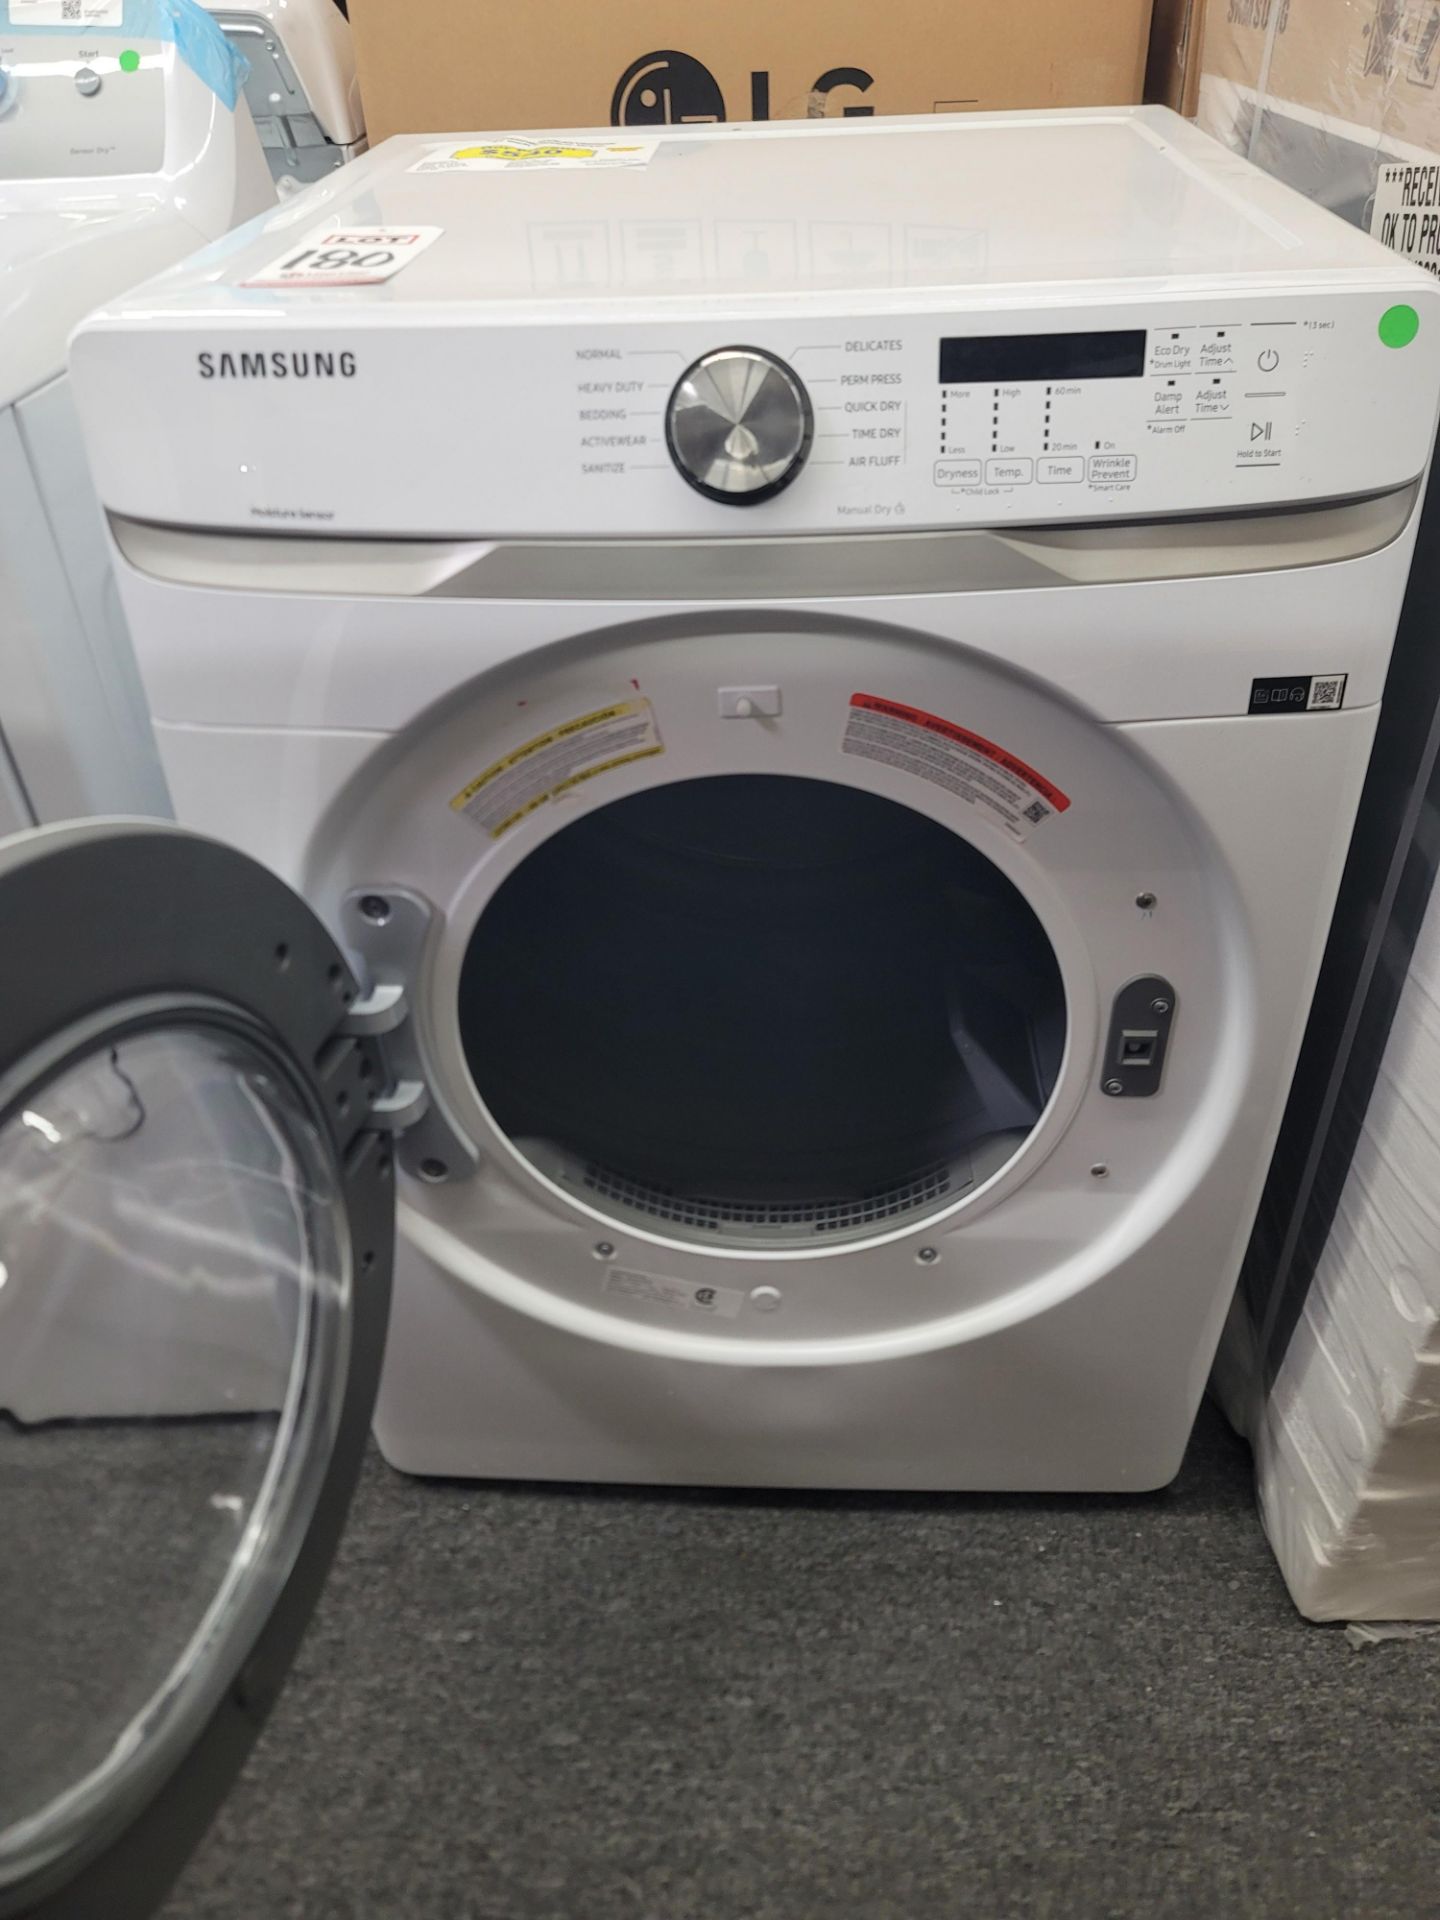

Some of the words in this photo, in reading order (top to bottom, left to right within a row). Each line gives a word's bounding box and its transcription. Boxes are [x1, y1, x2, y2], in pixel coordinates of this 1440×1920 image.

[1385, 165, 1440, 207] RECEI
[1381, 212, 1399, 250] OK
[1400, 213, 1417, 253] TO
[335, 235, 409, 244] LOT
[281, 249, 395, 270] 180
[845, 340, 903, 352] DELICATES
[1154, 345, 1171, 356] Eco
[1173, 345, 1190, 357] Dry
[1200, 344, 1232, 355] Adjust
[576, 350, 622, 360] NORMAL
[198, 352, 357, 378] SAMSUNG
[1174, 359, 1191, 370] Light
[1200, 357, 1223, 367] Time
[841, 375, 869, 386] PERM
[871, 373, 902, 384] PRESS
[578, 382, 613, 393] HEAVY
[615, 381, 644, 393] DUTY
[951, 390, 970, 398] More
[1003, 388, 1021, 398] High
[1154, 392, 1182, 404] Damp
[1196, 390, 1227, 402] Adjust
[845, 402, 877, 413] QUICK
[879, 401, 901, 411] DRY
[1155, 404, 1179, 415] Alert
[1195, 403, 1219, 413] Time
[579, 409, 626, 420] BEDDING
[852, 429, 877, 439] TIME
[879, 428, 901, 438] DRY
[1174, 425, 1185, 434] Off
[581, 436, 647, 447] ACTIVEWEAR
[1104, 441, 1115, 449] On
[949, 446, 965, 454] Less
[1000, 444, 1015, 453] Low
[1237, 449, 1254, 458] Hold
[1264, 449, 1281, 458] Start
[849, 457, 866, 467] AIR
[868, 456, 901, 466] FLUFF
[1093, 458, 1131, 468] Wrinkle
[582, 463, 625, 474] SANITIZE
[994, 467, 1024, 479] Temp.
[1048, 465, 1073, 476] Time
[1091, 469, 1131, 479] Prevent
[937, 468, 978, 481] Dryness
[984, 487, 999, 496] Lock
[1115, 484, 1131, 492] Care
[837, 505, 872, 515] Manual
[874, 505, 891, 516] Dry
